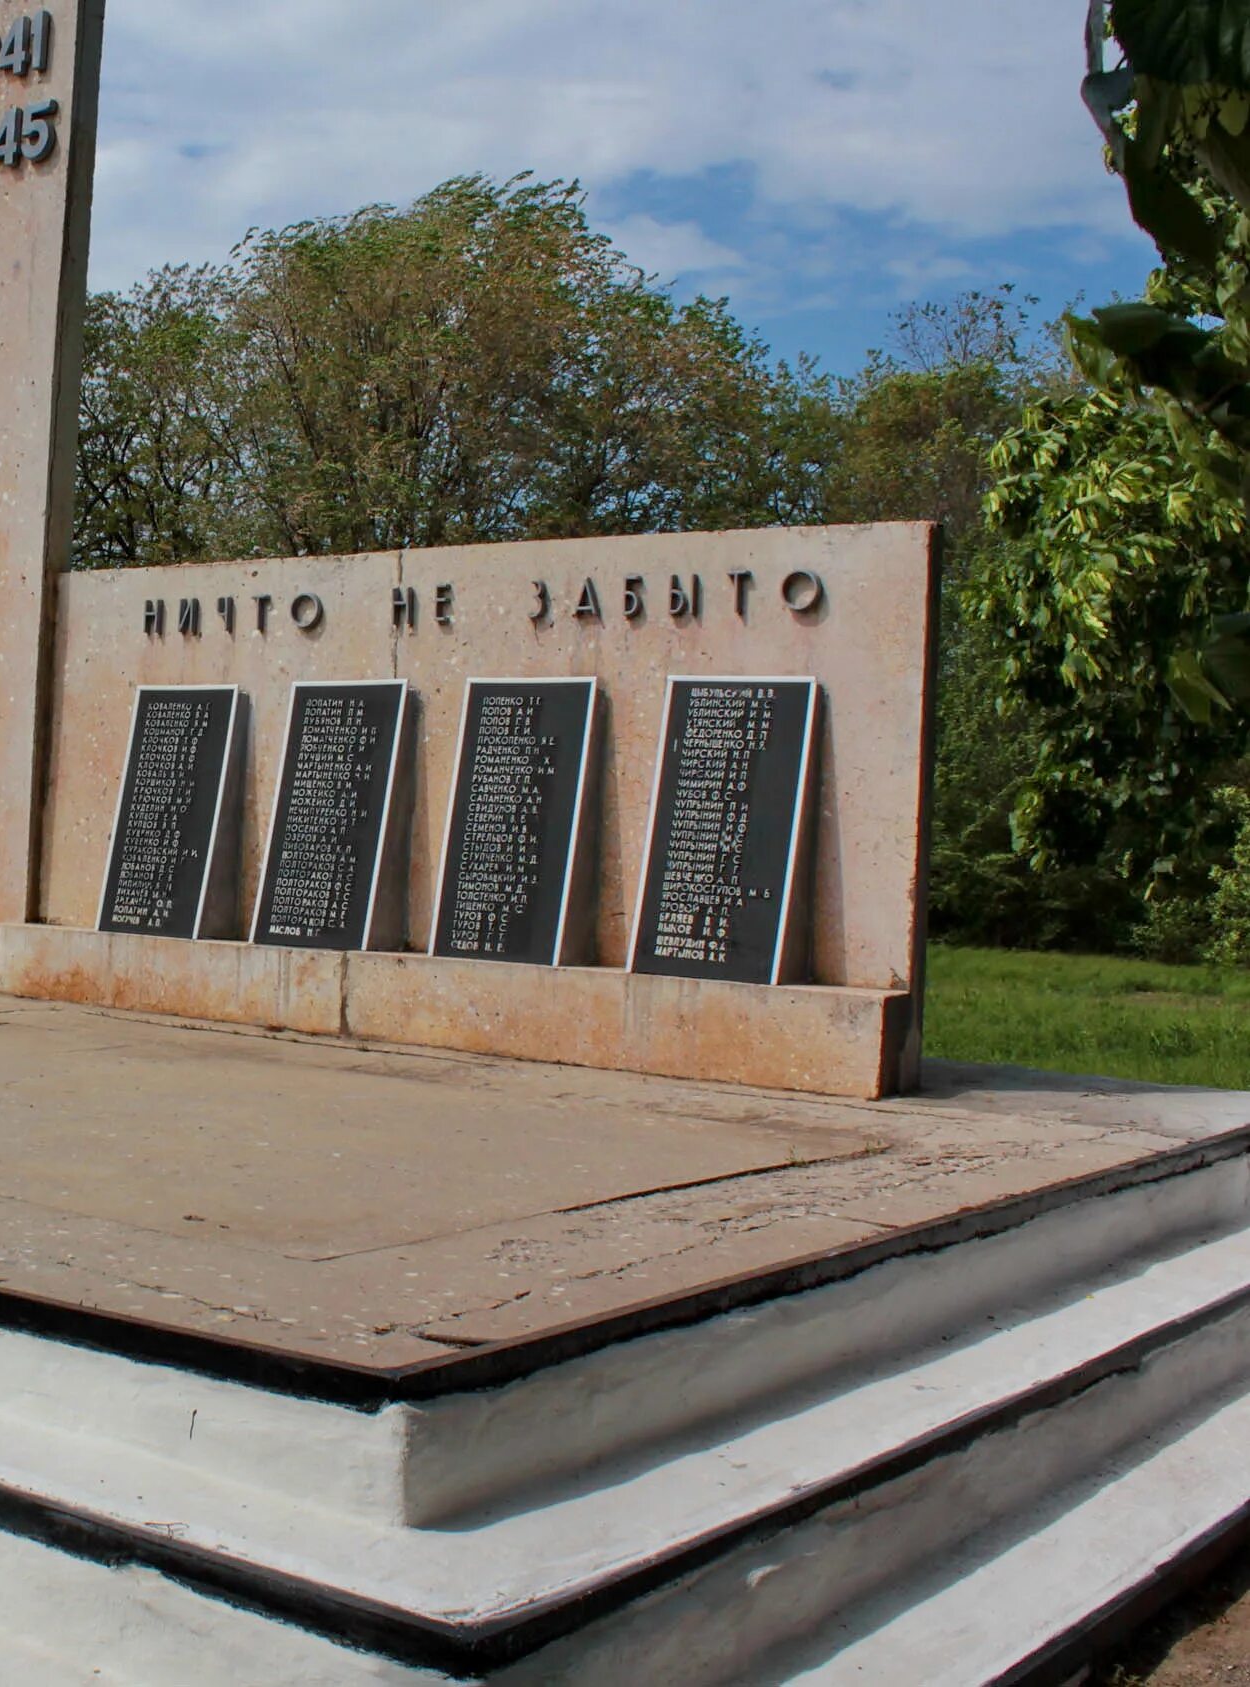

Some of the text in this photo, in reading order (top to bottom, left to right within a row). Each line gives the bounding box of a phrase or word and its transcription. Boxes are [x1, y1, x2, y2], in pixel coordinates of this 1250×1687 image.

[143, 570, 823, 636] НИЧТО НЕ ЗАБЫТО
[482, 707, 511, 716] ПОПОВ
[481, 717, 510, 725] ПОПОВ
[479, 727, 509, 735] ПОПОВ
[685, 728, 742, 738] ФЕДОРЕНКО
[478, 736, 536, 745] ПРОКОПЕНКО
[475, 755, 529, 764] РОМАНЕНКО
[474, 765, 533, 774] РОМАНЧЕНКО
[677, 789, 707, 799] ЧУБОВ
[675, 800, 724, 810] ЧУПРЫНИН
[674, 811, 722, 820] ЧУПРЫНИН
[672, 820, 721, 831] ЧУПРЫНИН
[671, 830, 719, 841] ЧУПРЫНИН
[670, 840, 717, 851] ЧУПРЫНИН
[668, 850, 715, 862] ЧУПРЫНИН
[664, 872, 714, 883] ШЕВЧЕНКО
